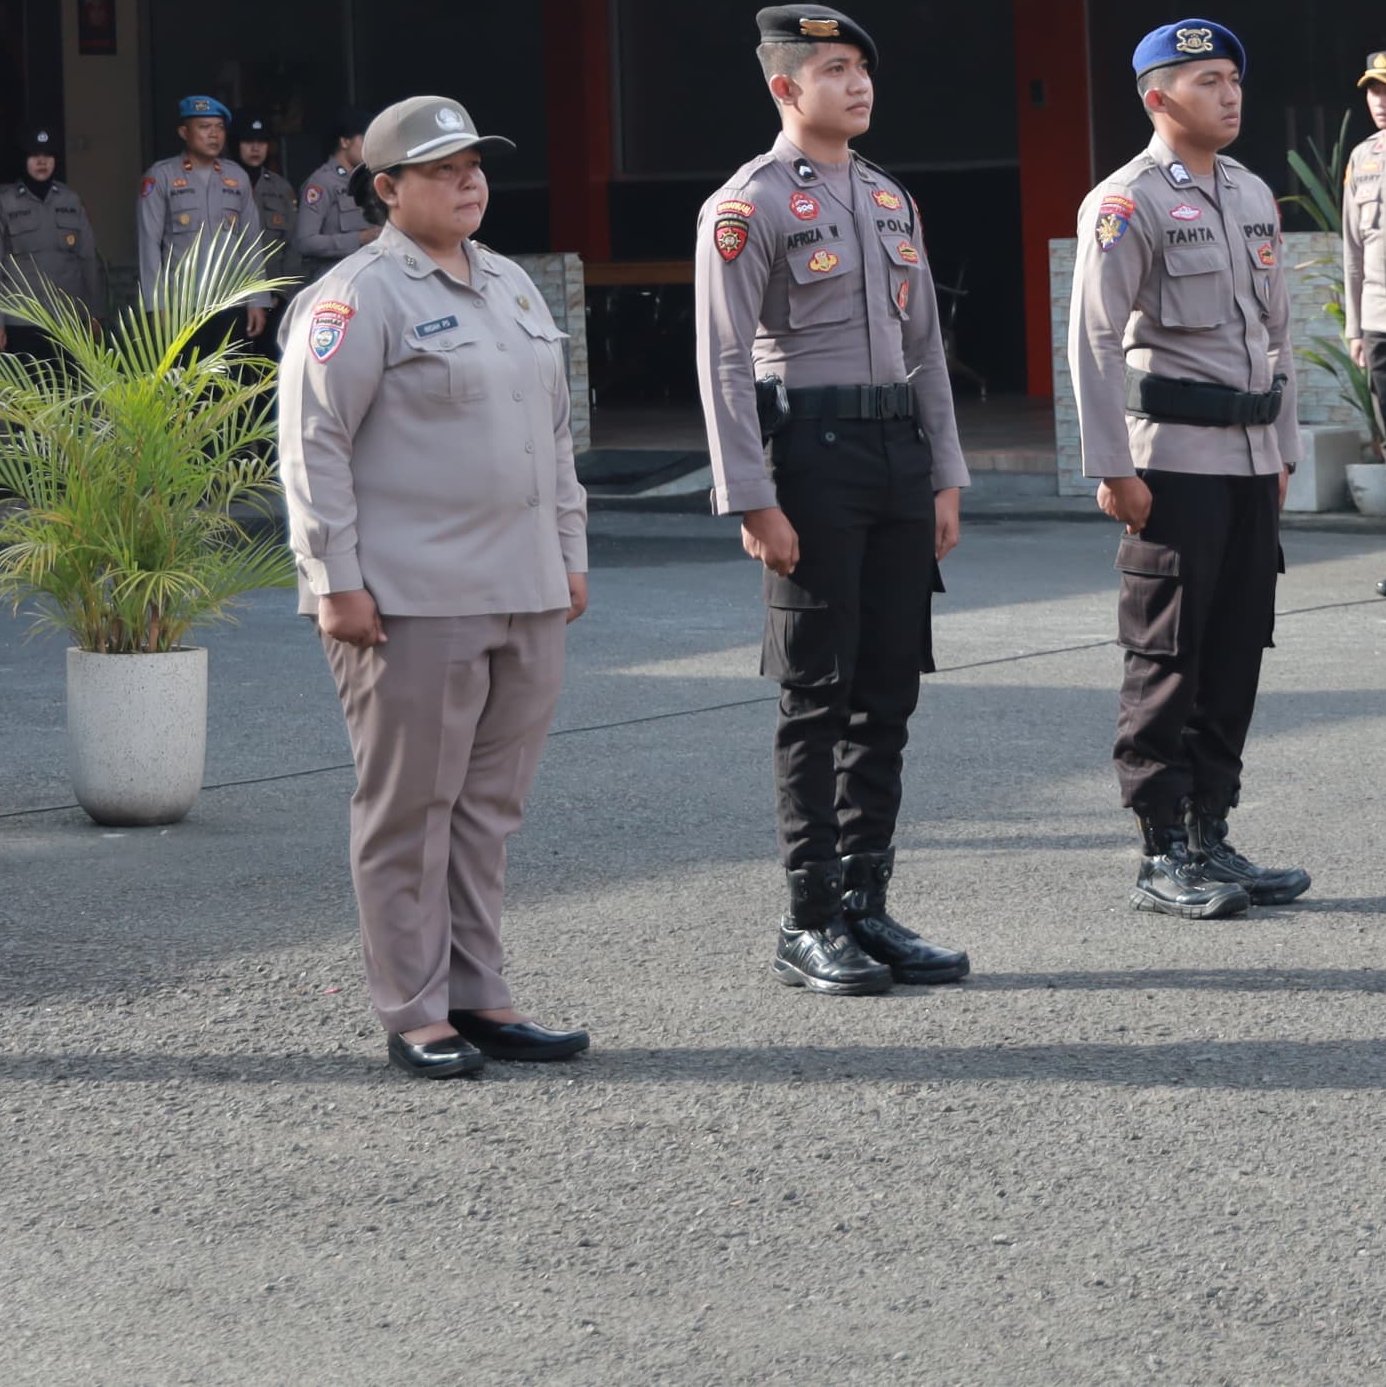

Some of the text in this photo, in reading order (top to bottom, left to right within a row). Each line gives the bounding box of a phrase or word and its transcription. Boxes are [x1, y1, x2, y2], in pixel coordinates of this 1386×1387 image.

[787, 224, 839, 250] AFRIZA W
[1166, 227, 1215, 244] TAHTA
